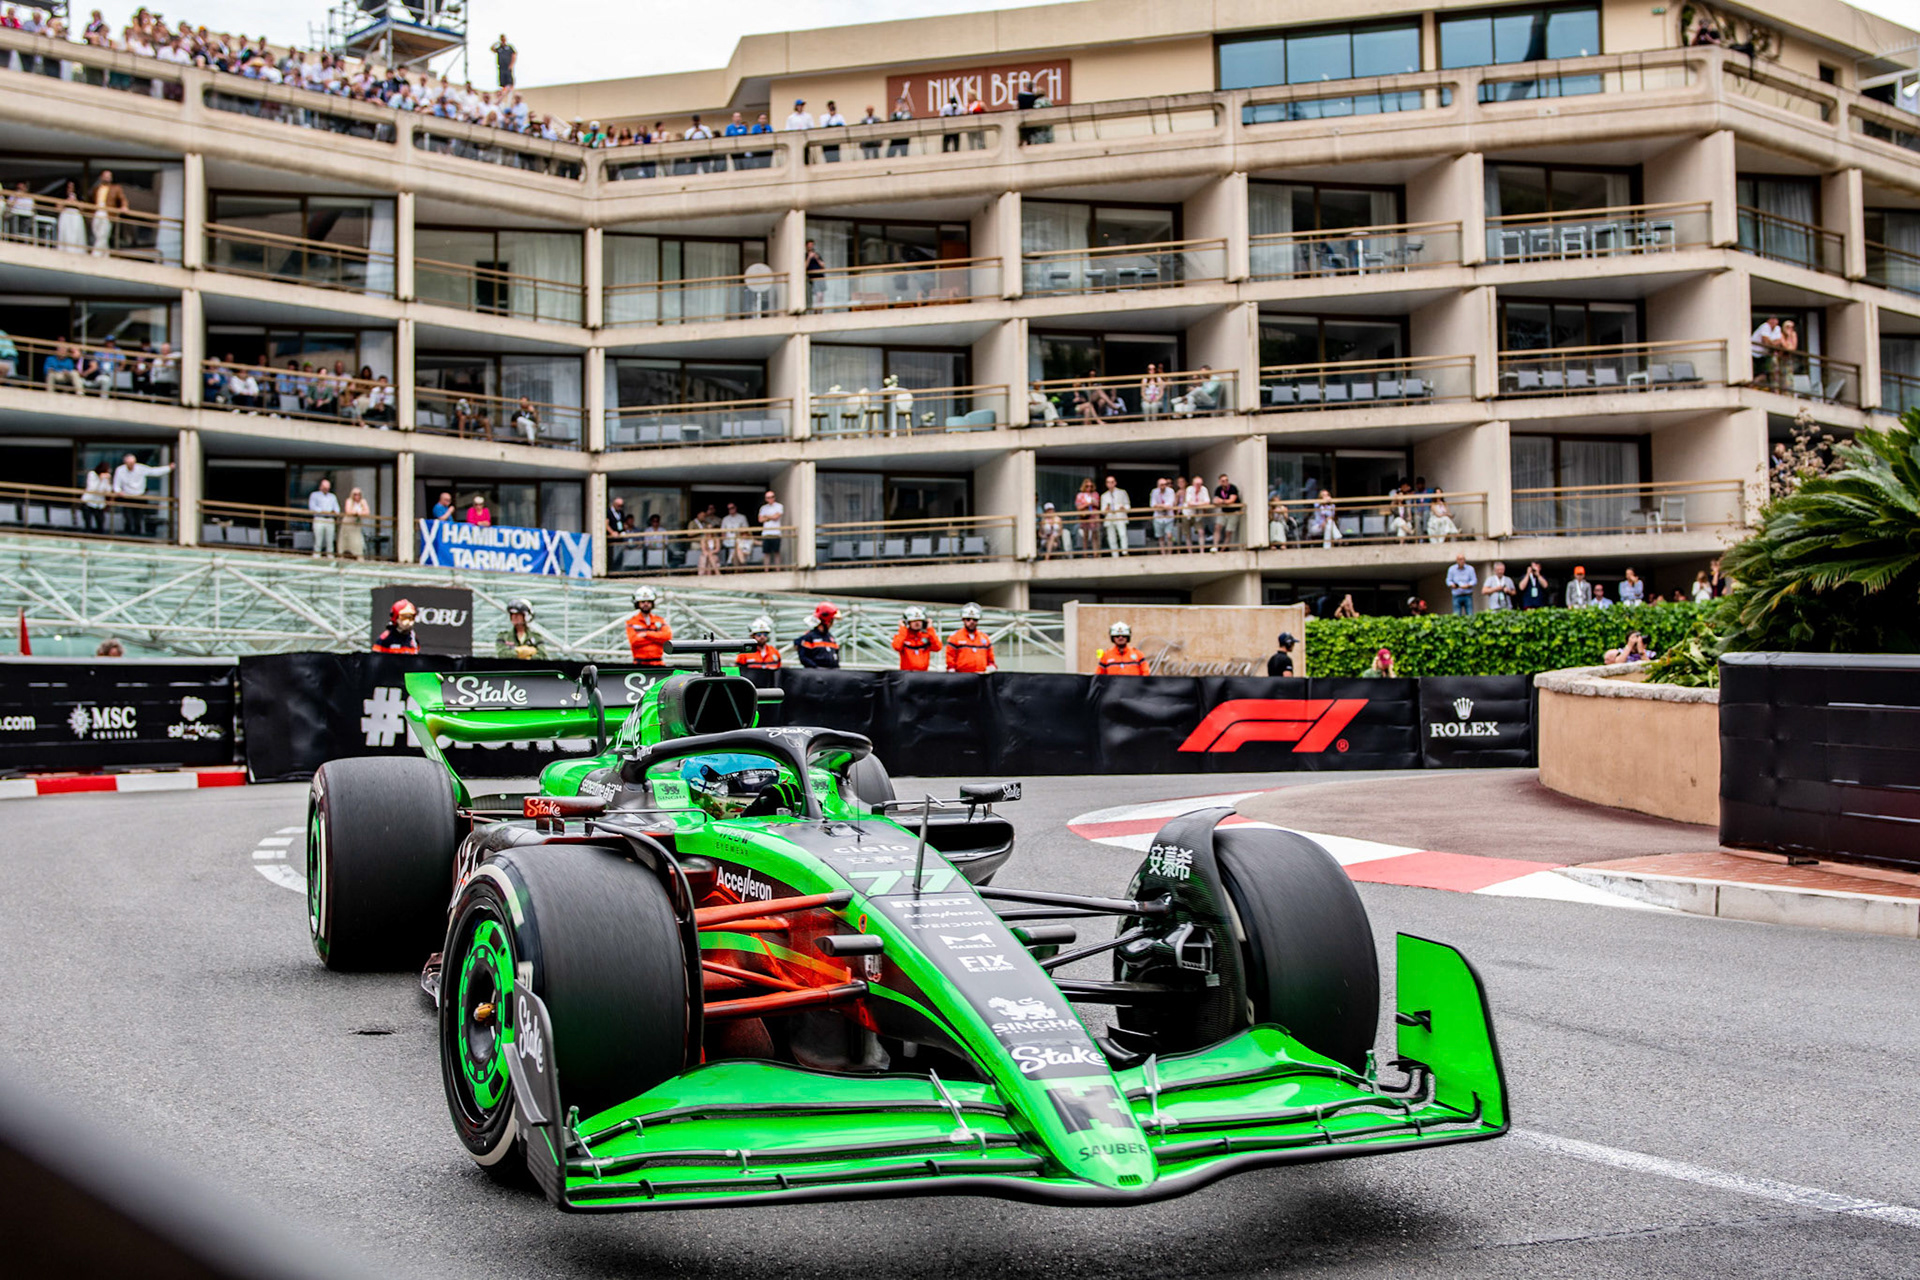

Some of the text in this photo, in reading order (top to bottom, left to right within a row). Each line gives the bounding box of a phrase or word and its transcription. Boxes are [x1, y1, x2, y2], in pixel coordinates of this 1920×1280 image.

[928, 68, 1062, 112] NIKKI BEACH
[442, 523, 541, 550] HAMILTON
[450, 548, 534, 572] TARMAC
[456, 676, 528, 706] Stake
[0, 715, 36, 731] .com
[91, 706, 137, 730] MSC
[1177, 699, 1369, 752] F1
[1430, 722, 1500, 738] ROLEX
[766, 727, 814, 738] Stake
[526, 798, 561, 817] Stake
[1149, 844, 1193, 881] 安慕希
[848, 868, 957, 896] 77
[890, 898, 973, 908] PIRELLI
[957, 954, 1011, 968] FIX
[518, 995, 544, 1074] Stake
[991, 1018, 1084, 1034] SINGHA
[1011, 1046, 1108, 1074] Stake
[1079, 1143, 1149, 1162] SAUBER
